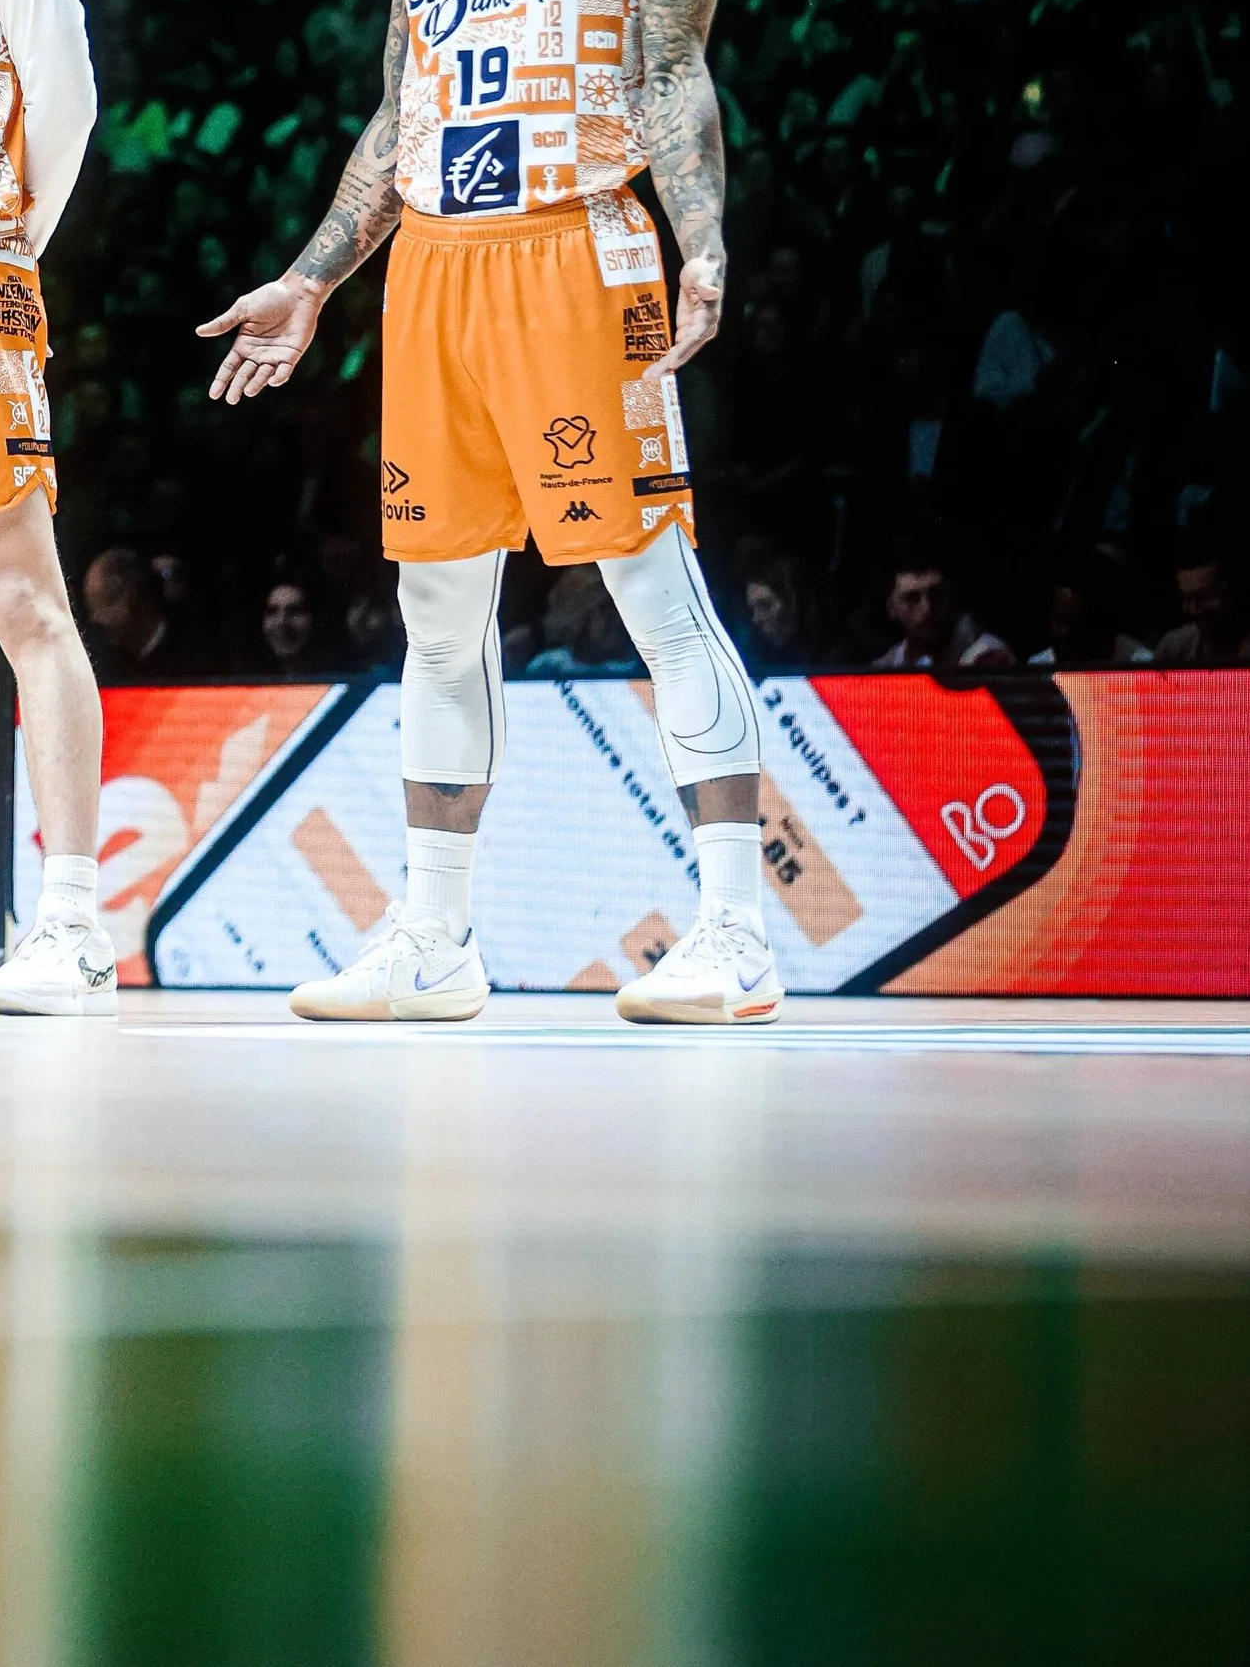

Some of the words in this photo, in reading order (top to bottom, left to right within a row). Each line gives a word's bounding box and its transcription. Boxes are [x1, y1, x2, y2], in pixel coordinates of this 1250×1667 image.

[542, 0, 563, 27] 12
[537, 32, 563, 58] 23
[456, 46, 509, 106] 19
[541, 476, 613, 489] Hauts-de-France
[762, 688, 784, 712] 2
